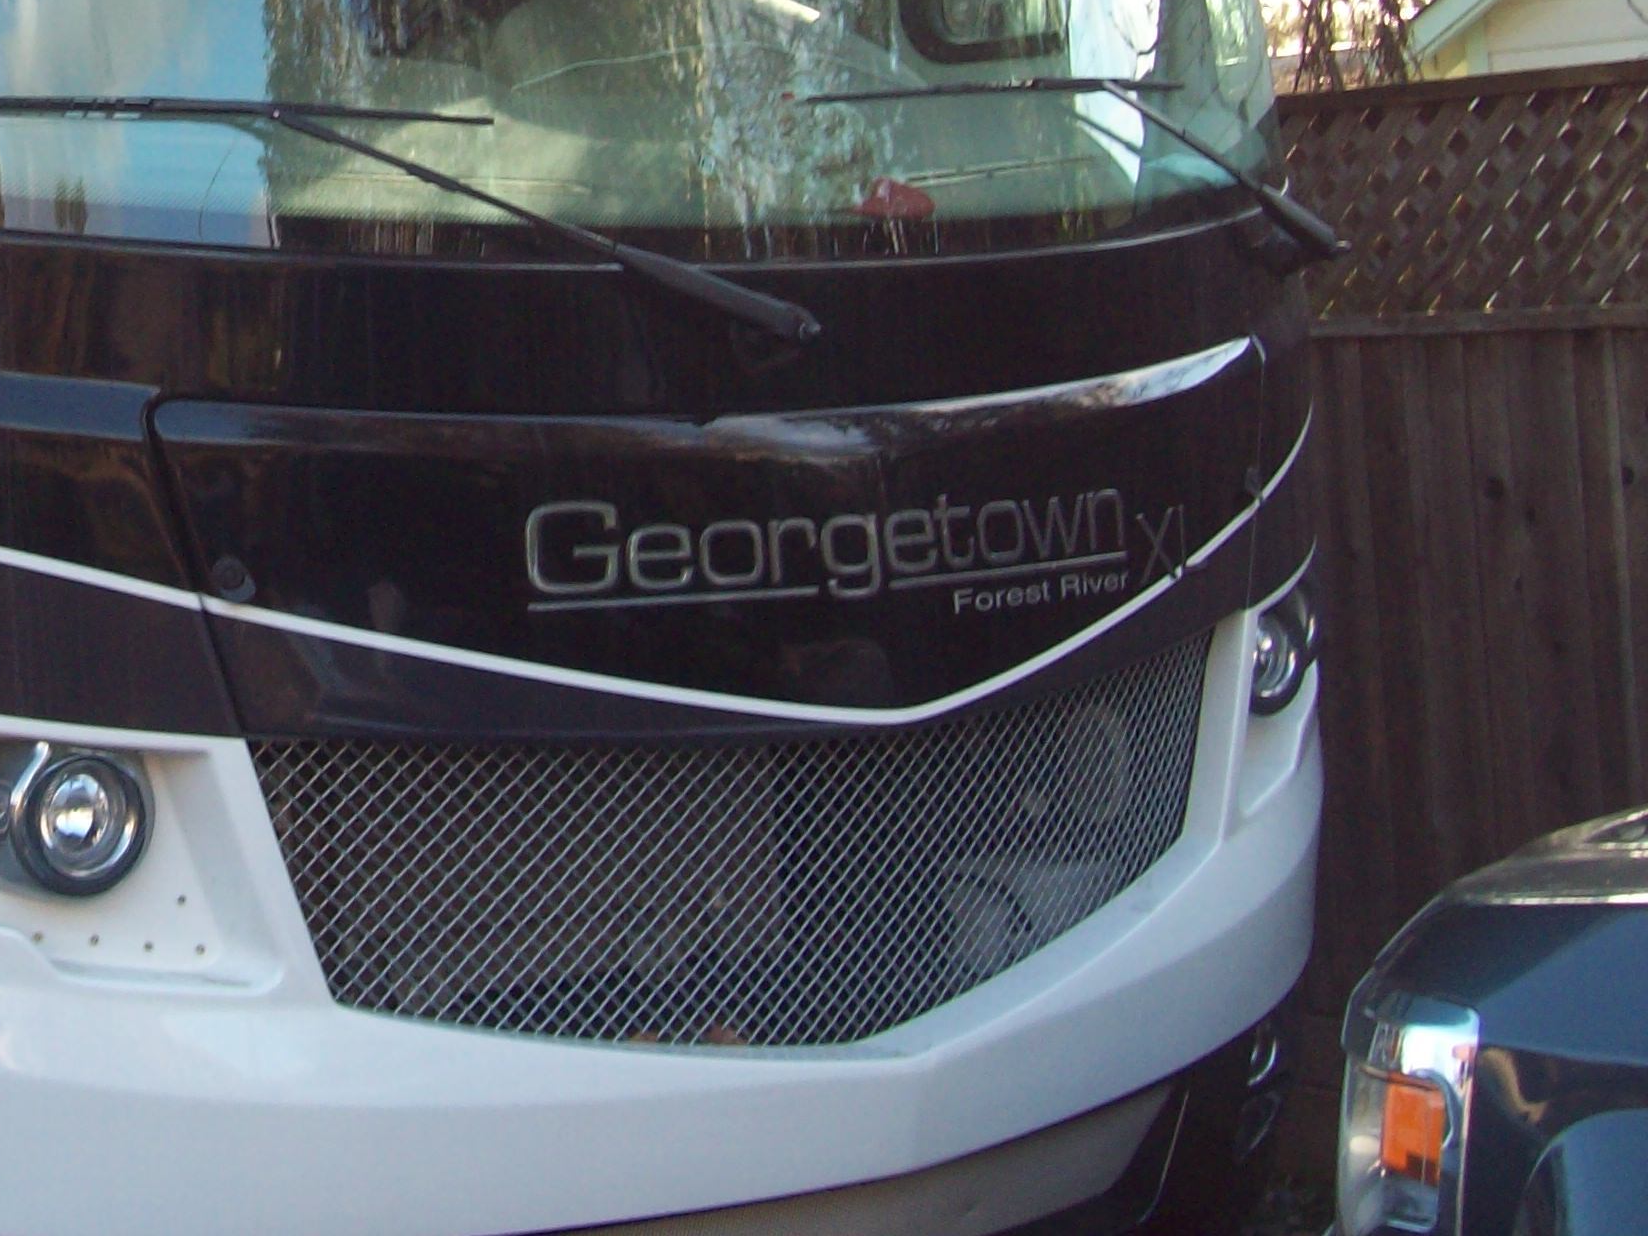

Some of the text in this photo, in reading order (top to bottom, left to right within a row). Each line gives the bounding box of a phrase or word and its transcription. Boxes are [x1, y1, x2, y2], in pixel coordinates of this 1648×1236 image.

[525, 487, 1125, 599] Georgetown
[953, 570, 1128, 615] Forest River
